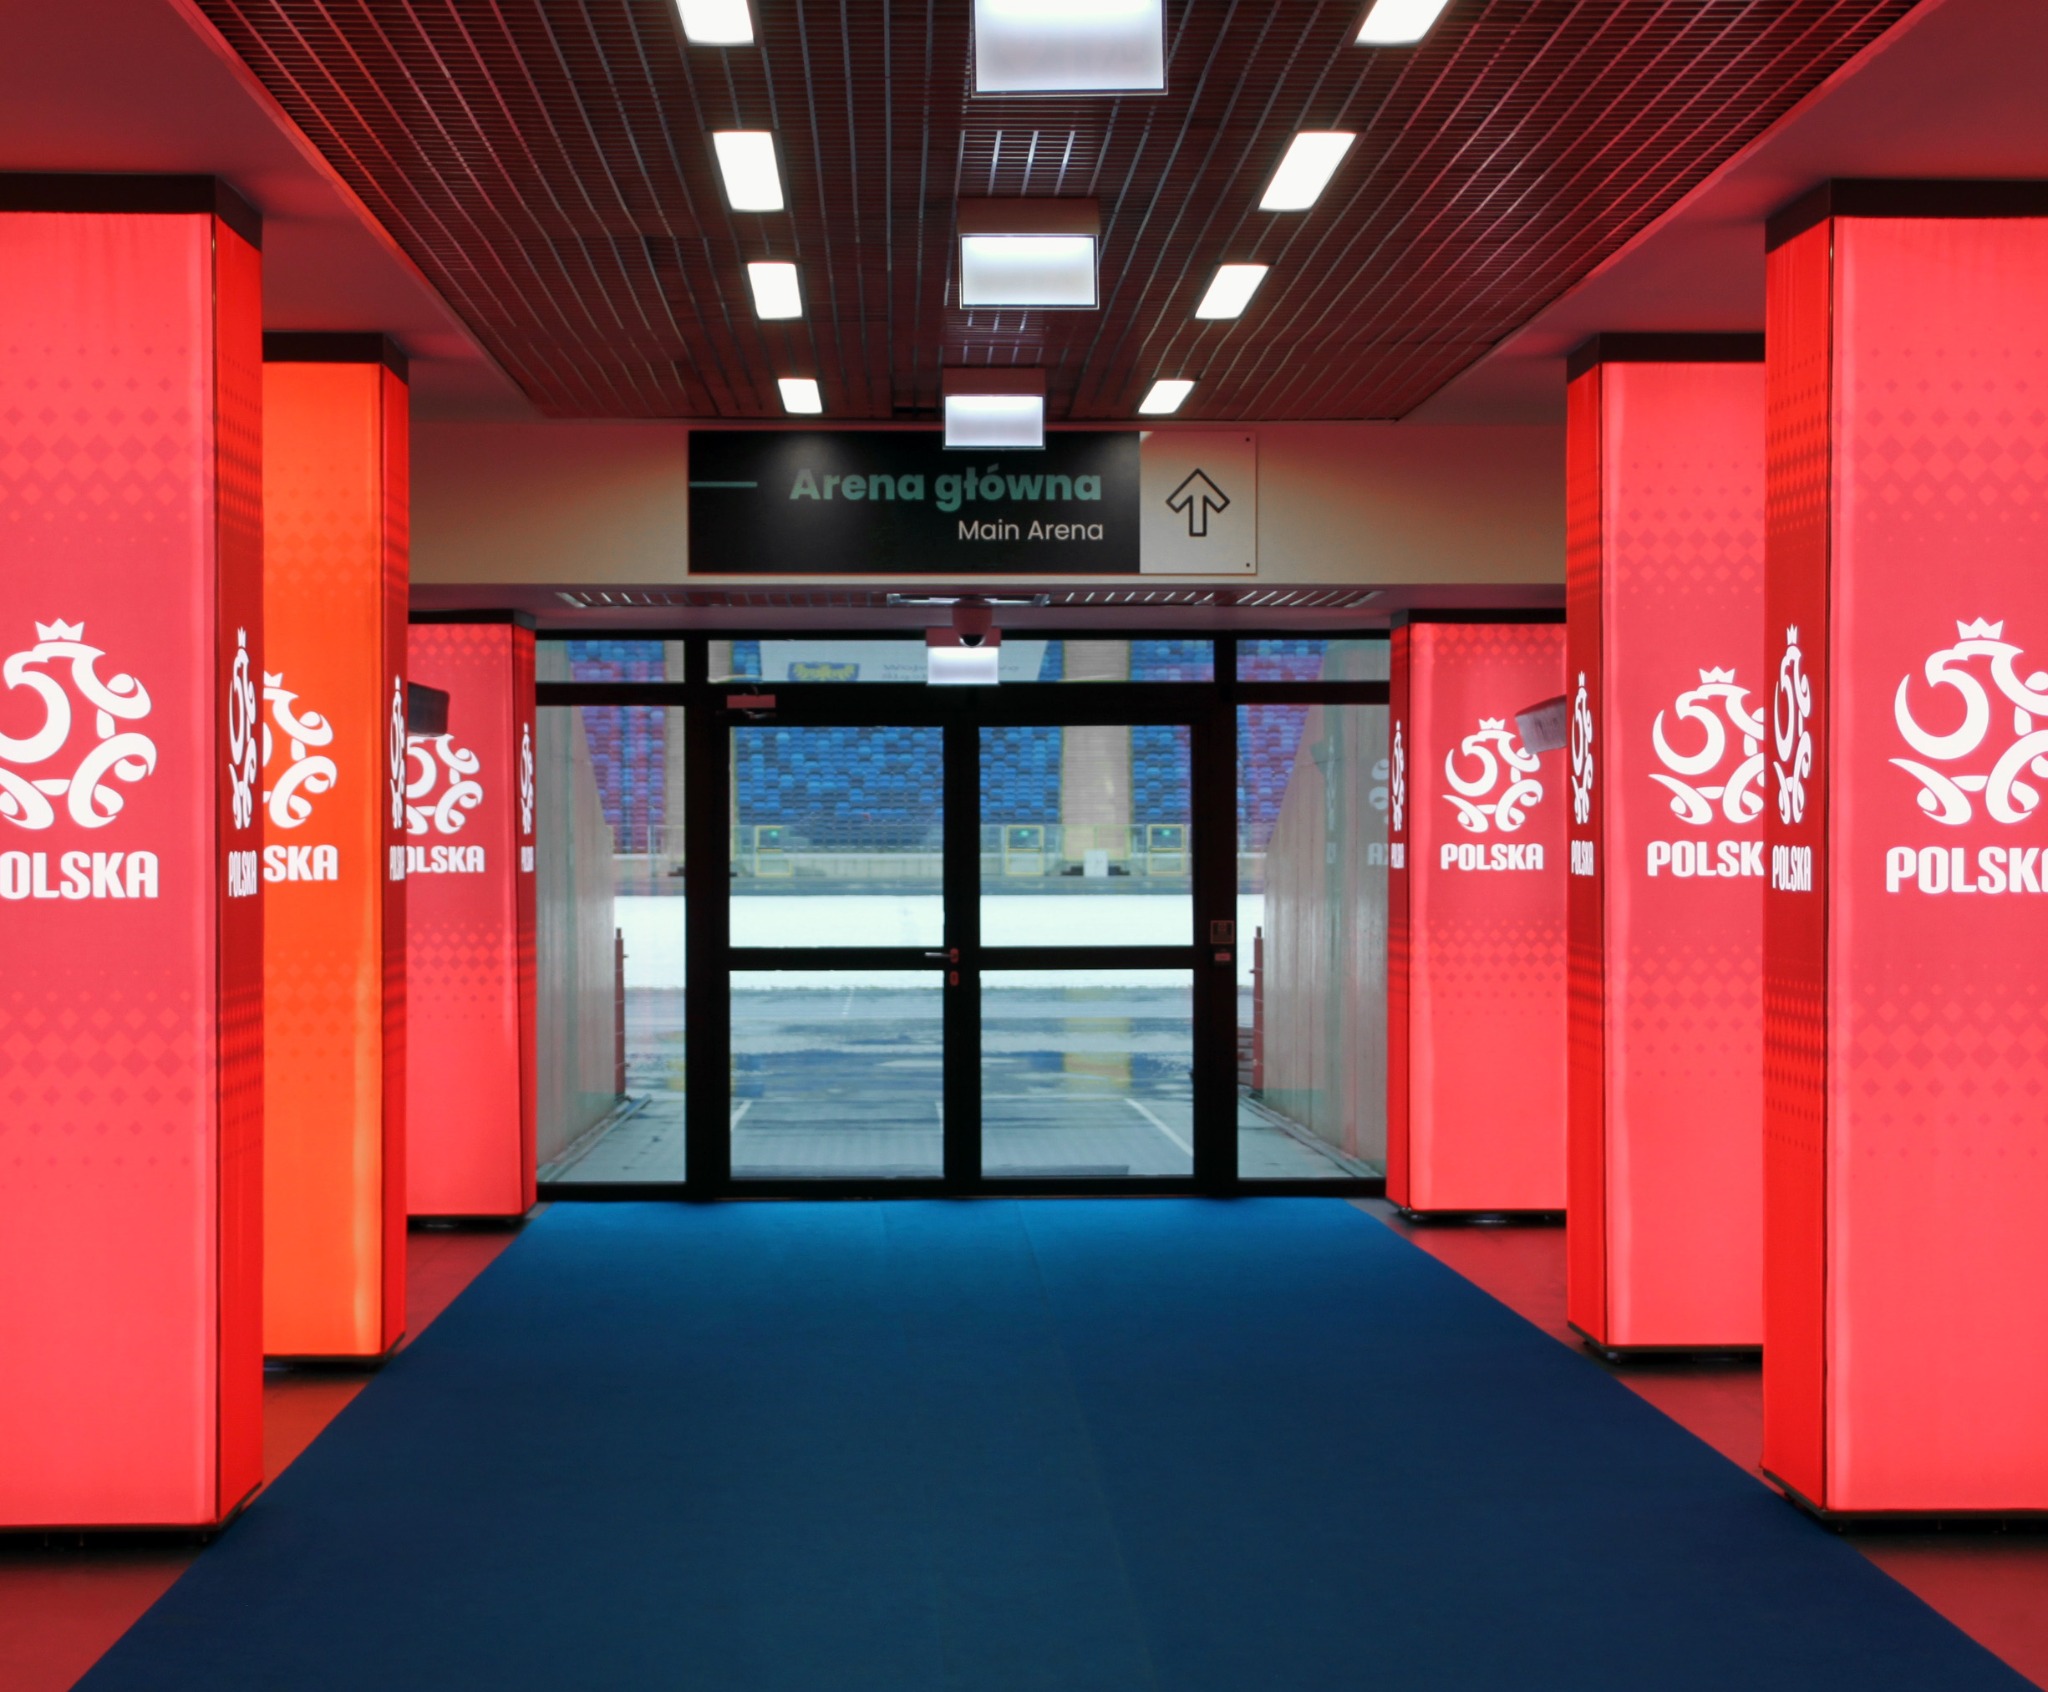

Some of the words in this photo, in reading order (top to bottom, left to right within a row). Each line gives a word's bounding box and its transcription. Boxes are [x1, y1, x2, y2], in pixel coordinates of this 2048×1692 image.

[789, 468, 926, 502] Arena
[936, 463, 1102, 512] główna
[958, 519, 1020, 541] Main
[1027, 520, 1104, 541] Arena
[0, 850, 159, 900] OLSKA
[228, 850, 258, 898] POLSKA
[263, 844, 338, 883] SKA
[1440, 842, 1544, 872] POLSKA
[1646, 840, 1765, 878] POLSK
[1772, 844, 1812, 892] POLSKA
[1885, 846, 2048, 895] POLSK
